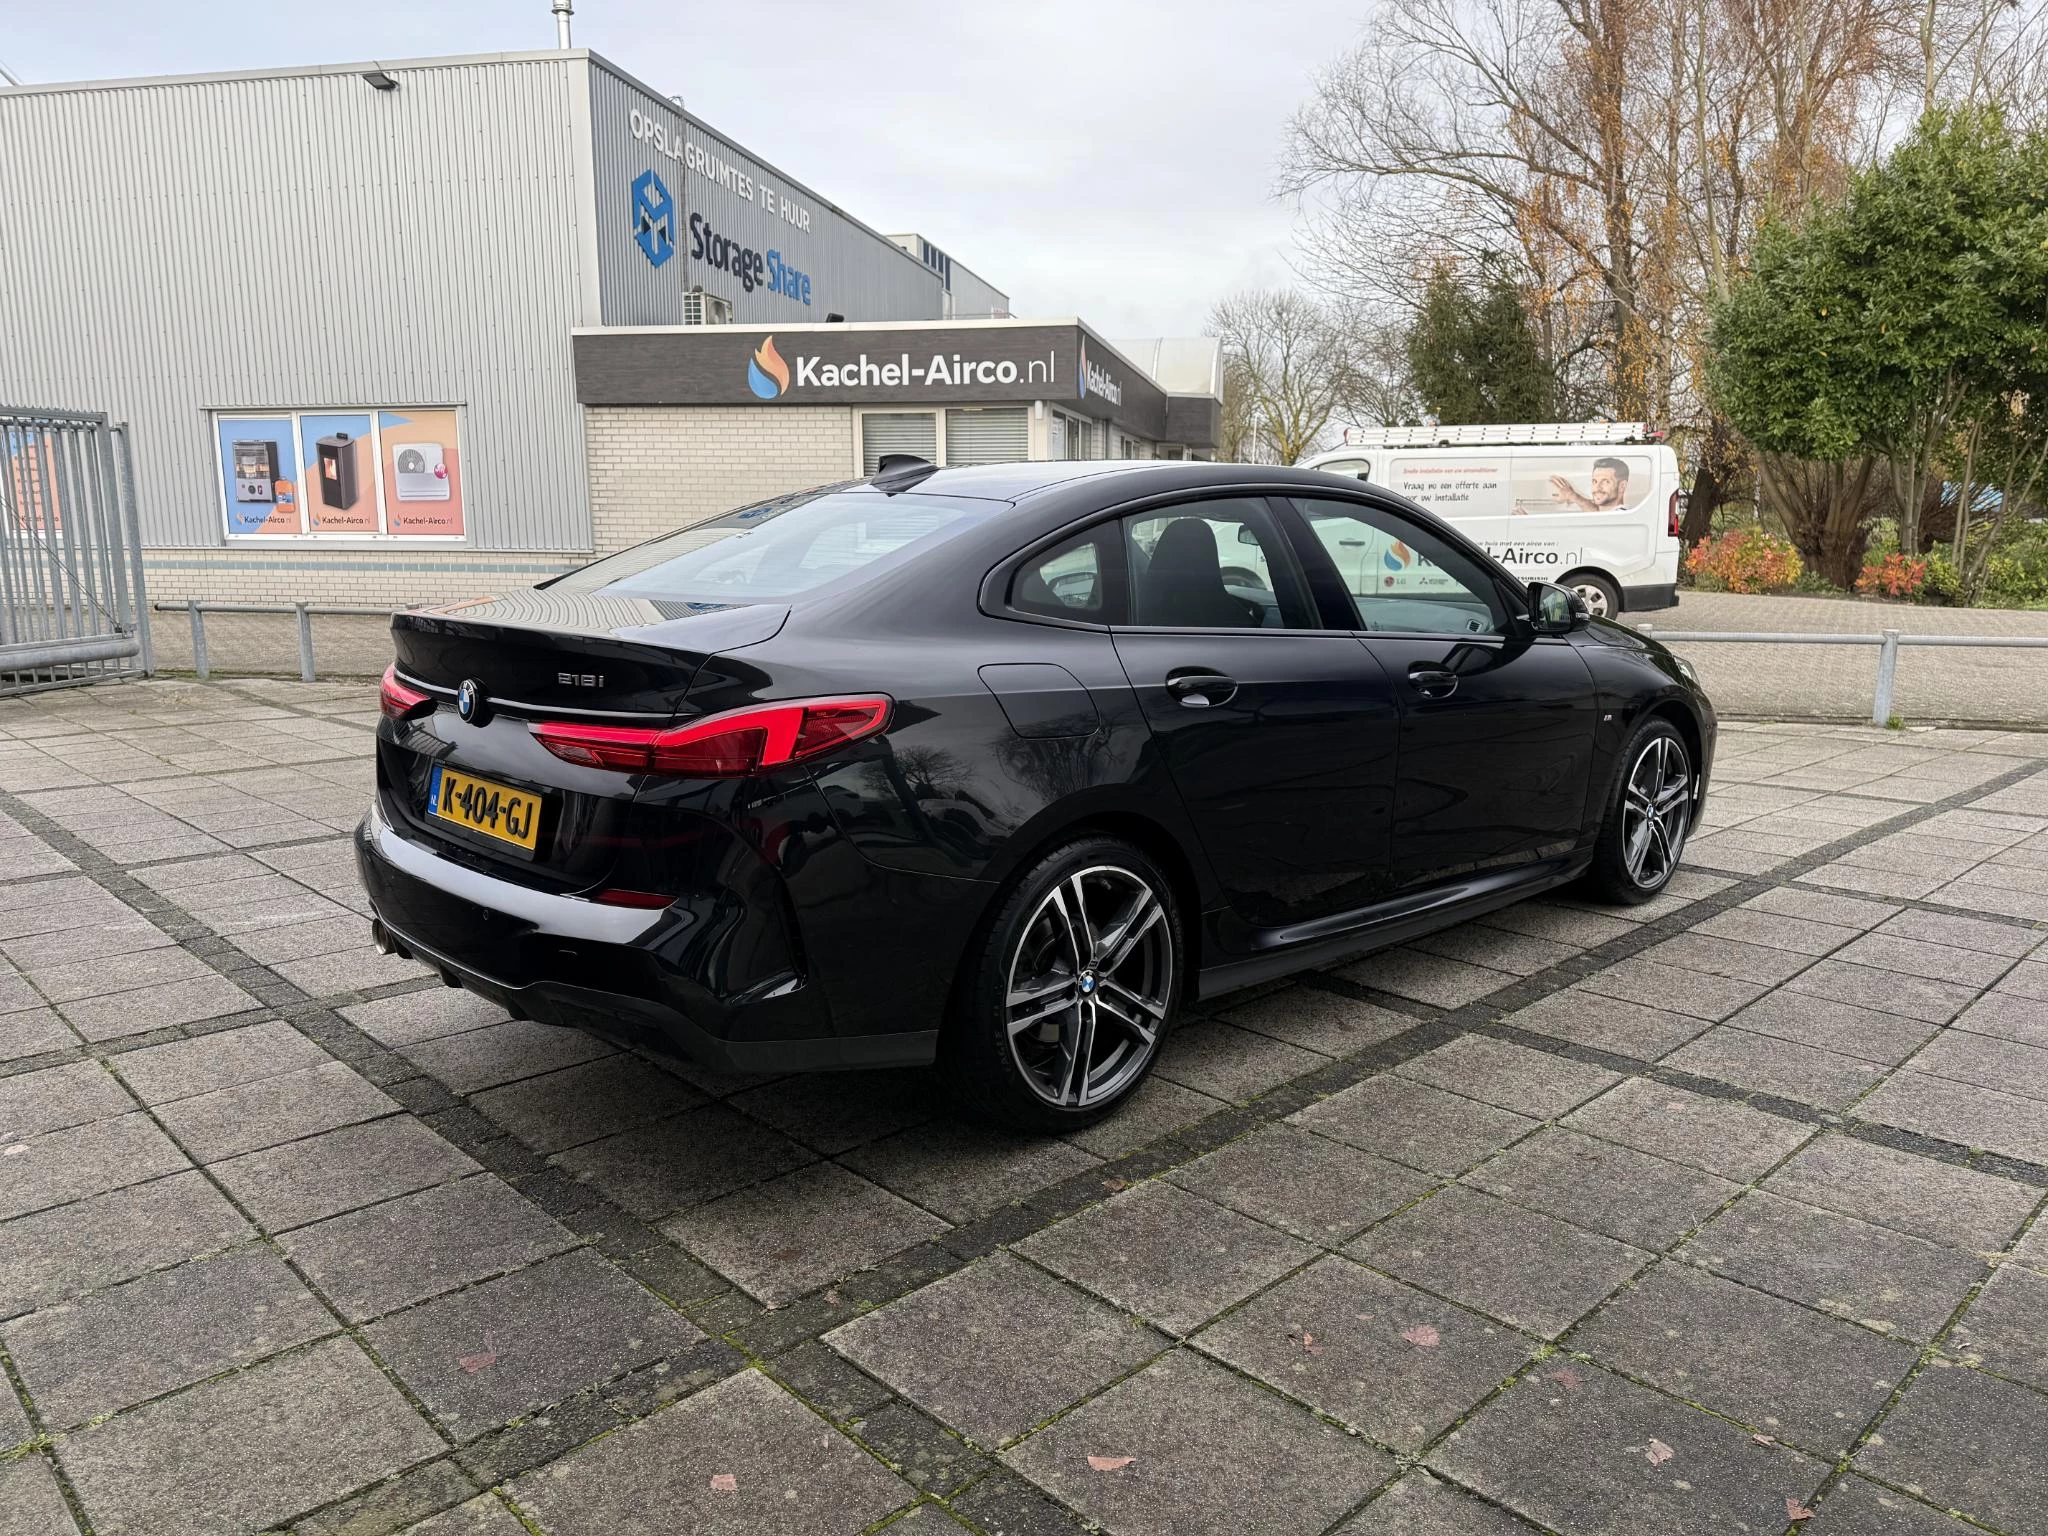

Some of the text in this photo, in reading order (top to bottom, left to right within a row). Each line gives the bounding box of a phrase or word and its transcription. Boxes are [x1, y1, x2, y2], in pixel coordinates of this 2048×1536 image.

[630, 109, 810, 233] OPSLAGRUIMTES TE HUUR
[690, 213, 811, 305] Storage Share
[796, 350, 1055, 387] Kachel-Airco.nl
[1403, 481, 1424, 491] Vraag
[1455, 481, 1479, 489] offerte
[1434, 493, 1470, 502] installatie
[558, 672, 604, 688] 218i
[442, 776, 534, 839] K-404-GJ
